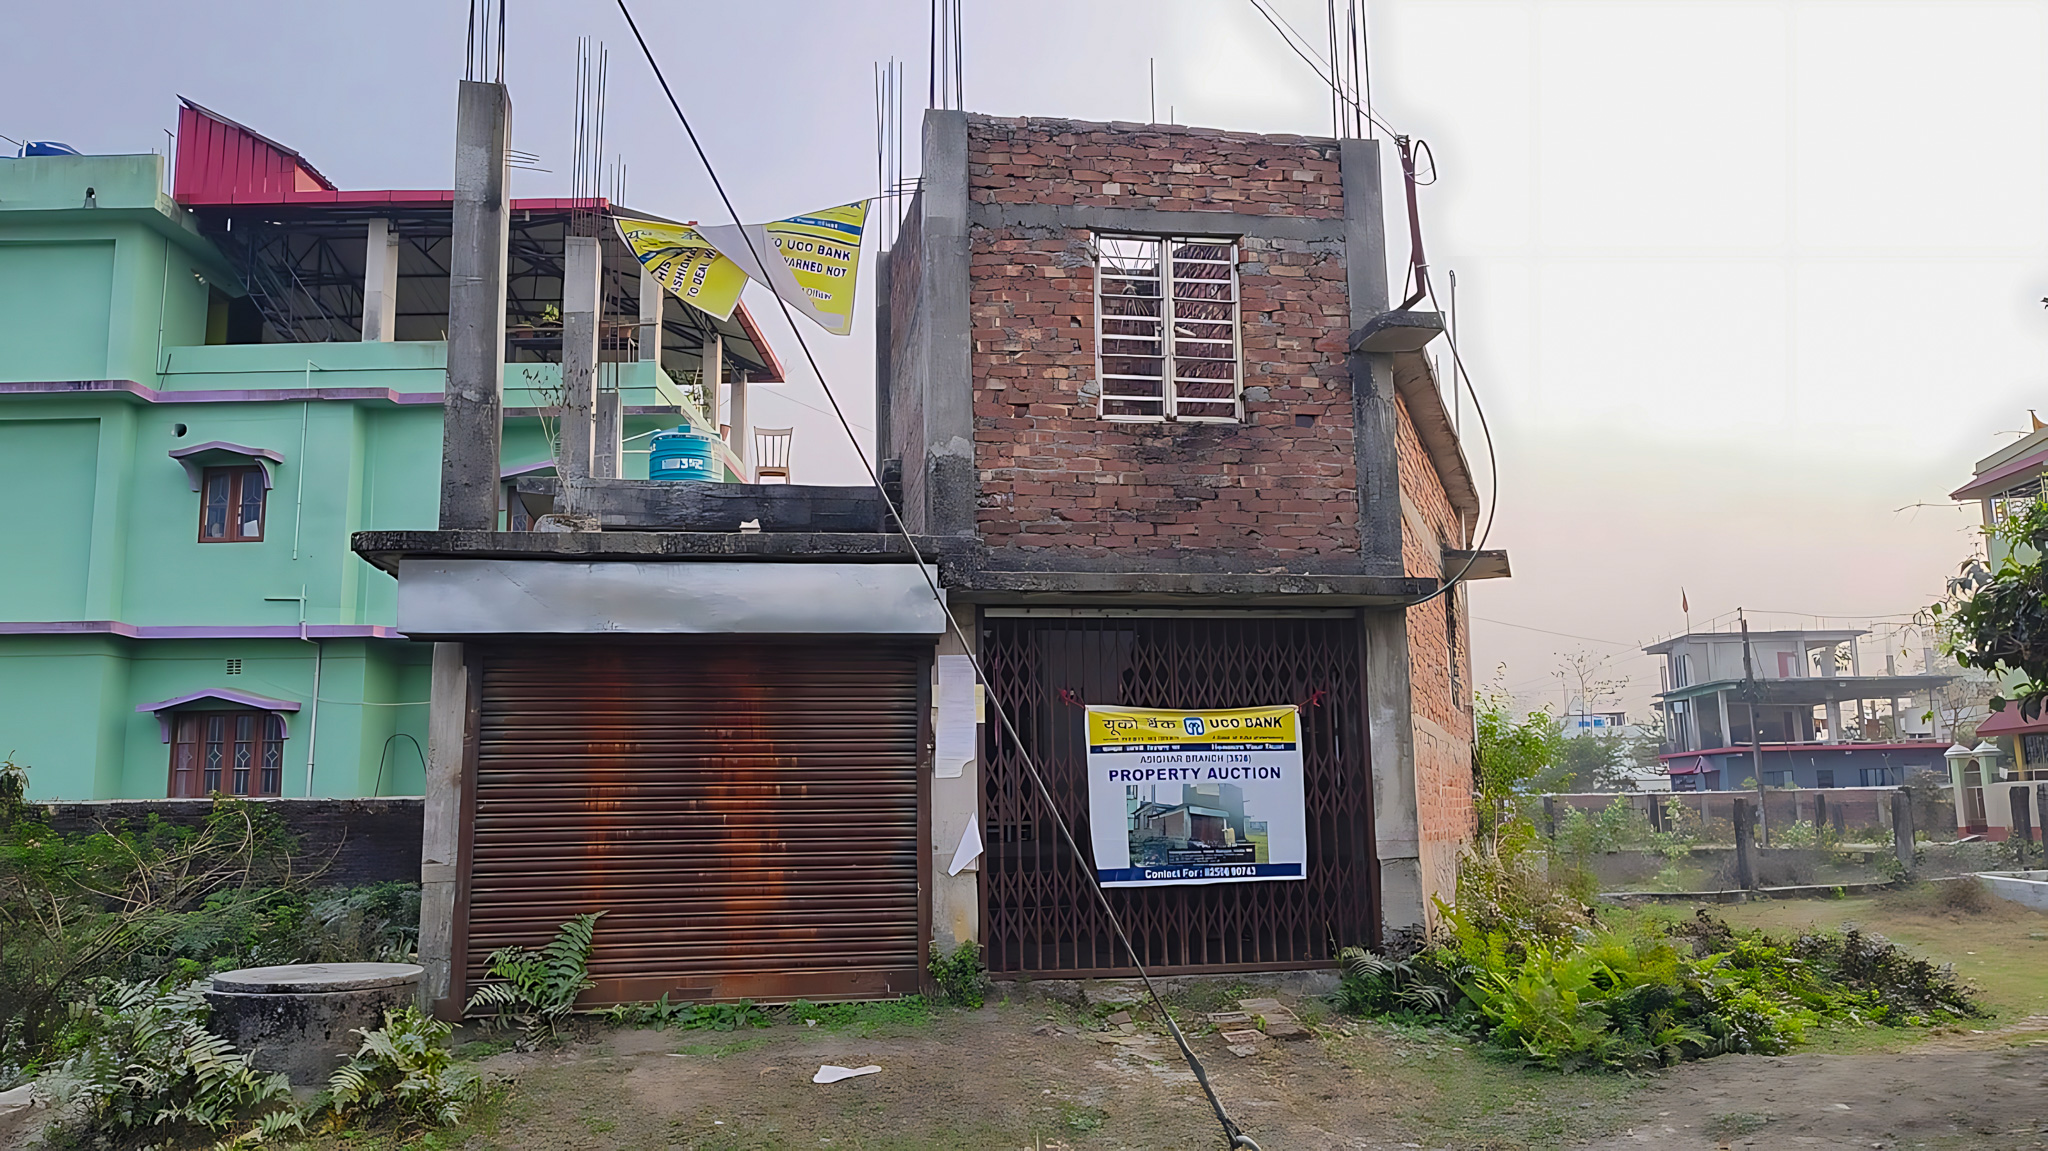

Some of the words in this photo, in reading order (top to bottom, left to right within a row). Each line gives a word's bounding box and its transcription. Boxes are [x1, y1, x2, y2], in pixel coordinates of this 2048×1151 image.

[787, 239, 814, 252] UCO
[817, 244, 851, 261] BANK
[826, 266, 847, 277] NOT
[687, 287, 699, 297] TO
[693, 263, 709, 286] DEAL
[1102, 717, 1138, 736] यूको
[1209, 718, 1240, 728] UCO
[1244, 717, 1283, 728] BANK
[1108, 767, 1201, 781] PROPERTY
[1207, 766, 1281, 780] AUCTION
[1145, 869, 1181, 879] Contact
